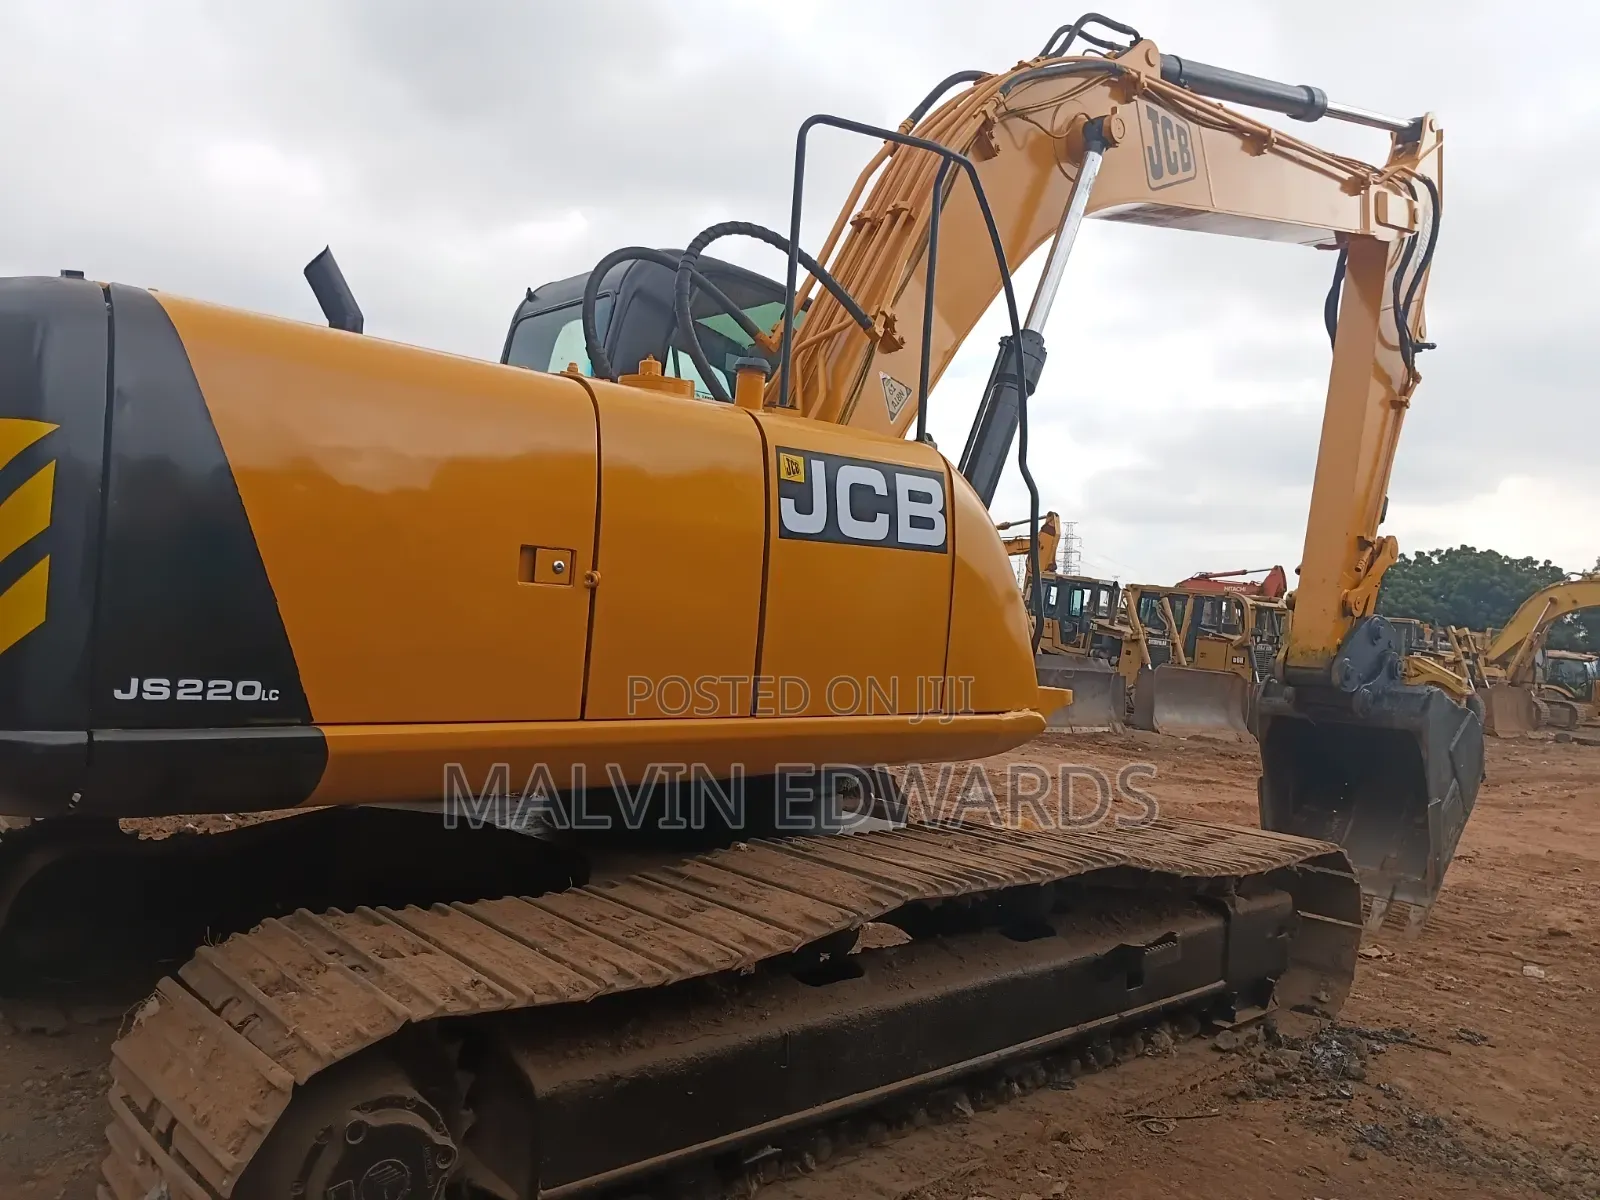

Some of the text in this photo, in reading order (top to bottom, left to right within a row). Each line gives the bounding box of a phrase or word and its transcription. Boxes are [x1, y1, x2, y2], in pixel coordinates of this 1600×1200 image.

[1146, 105, 1192, 181] JCB
[780, 459, 947, 547] JCB
[785, 457, 801, 477] JCB
